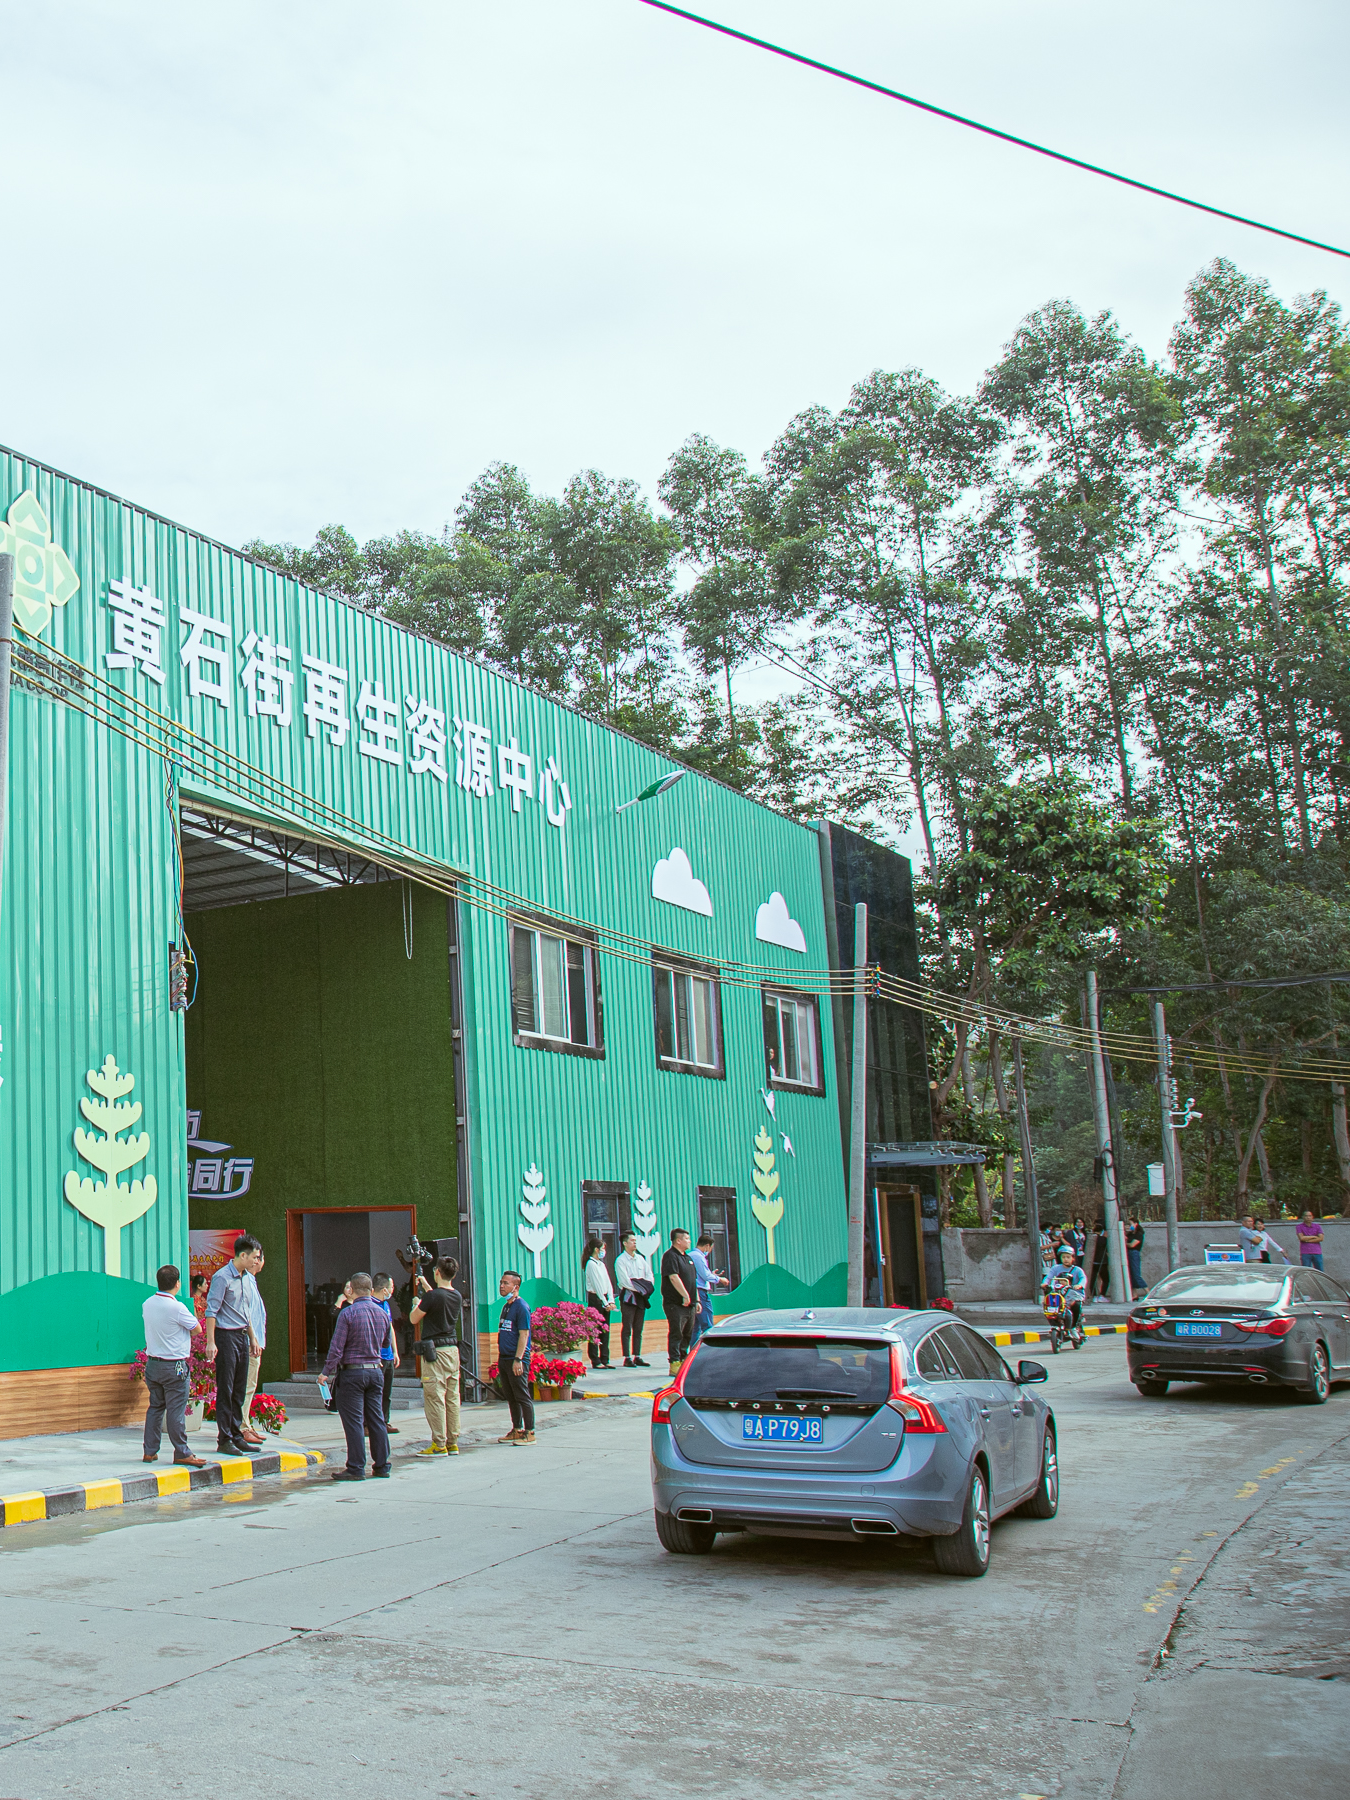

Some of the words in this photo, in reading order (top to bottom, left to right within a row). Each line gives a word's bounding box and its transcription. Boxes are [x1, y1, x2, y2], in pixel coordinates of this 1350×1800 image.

[11, 640, 86, 692] 销合作社
[104, 575, 572, 828] 黄石街再生资源中心
[187, 1157, 254, 1194] 同行
[728, 1401, 831, 1412] VOLVO
